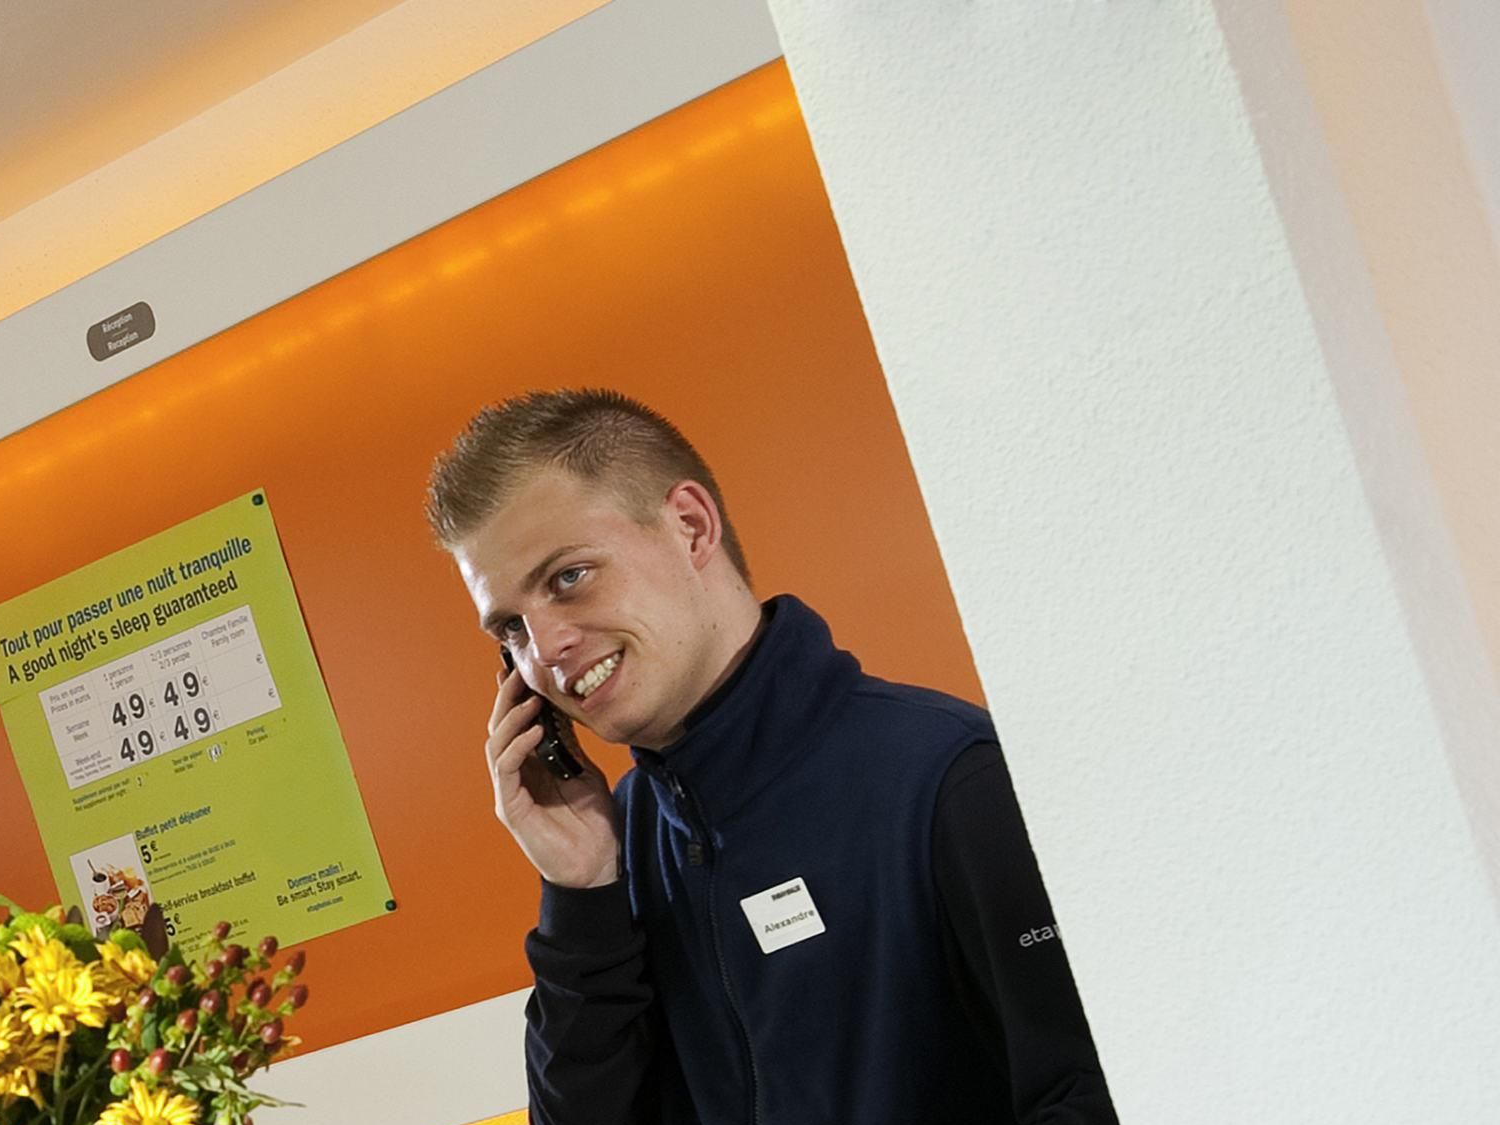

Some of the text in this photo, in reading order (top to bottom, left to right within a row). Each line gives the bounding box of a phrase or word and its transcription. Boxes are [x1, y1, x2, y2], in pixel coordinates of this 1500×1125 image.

[0, 536, 252, 657] Tout pour passer une nuit tranquille
[8, 570, 238, 684] A good night's sleep guaranteed
[135, 805, 212, 841] Buffet petit déjeuner
[199, 878, 234, 899] breakfast
[233, 871, 257, 887] buffet
[276, 895, 289, 906] Be
[316, 880, 336, 893] Stay
[287, 872, 317, 890] Dormez
[764, 909, 815, 934] Alexandre
